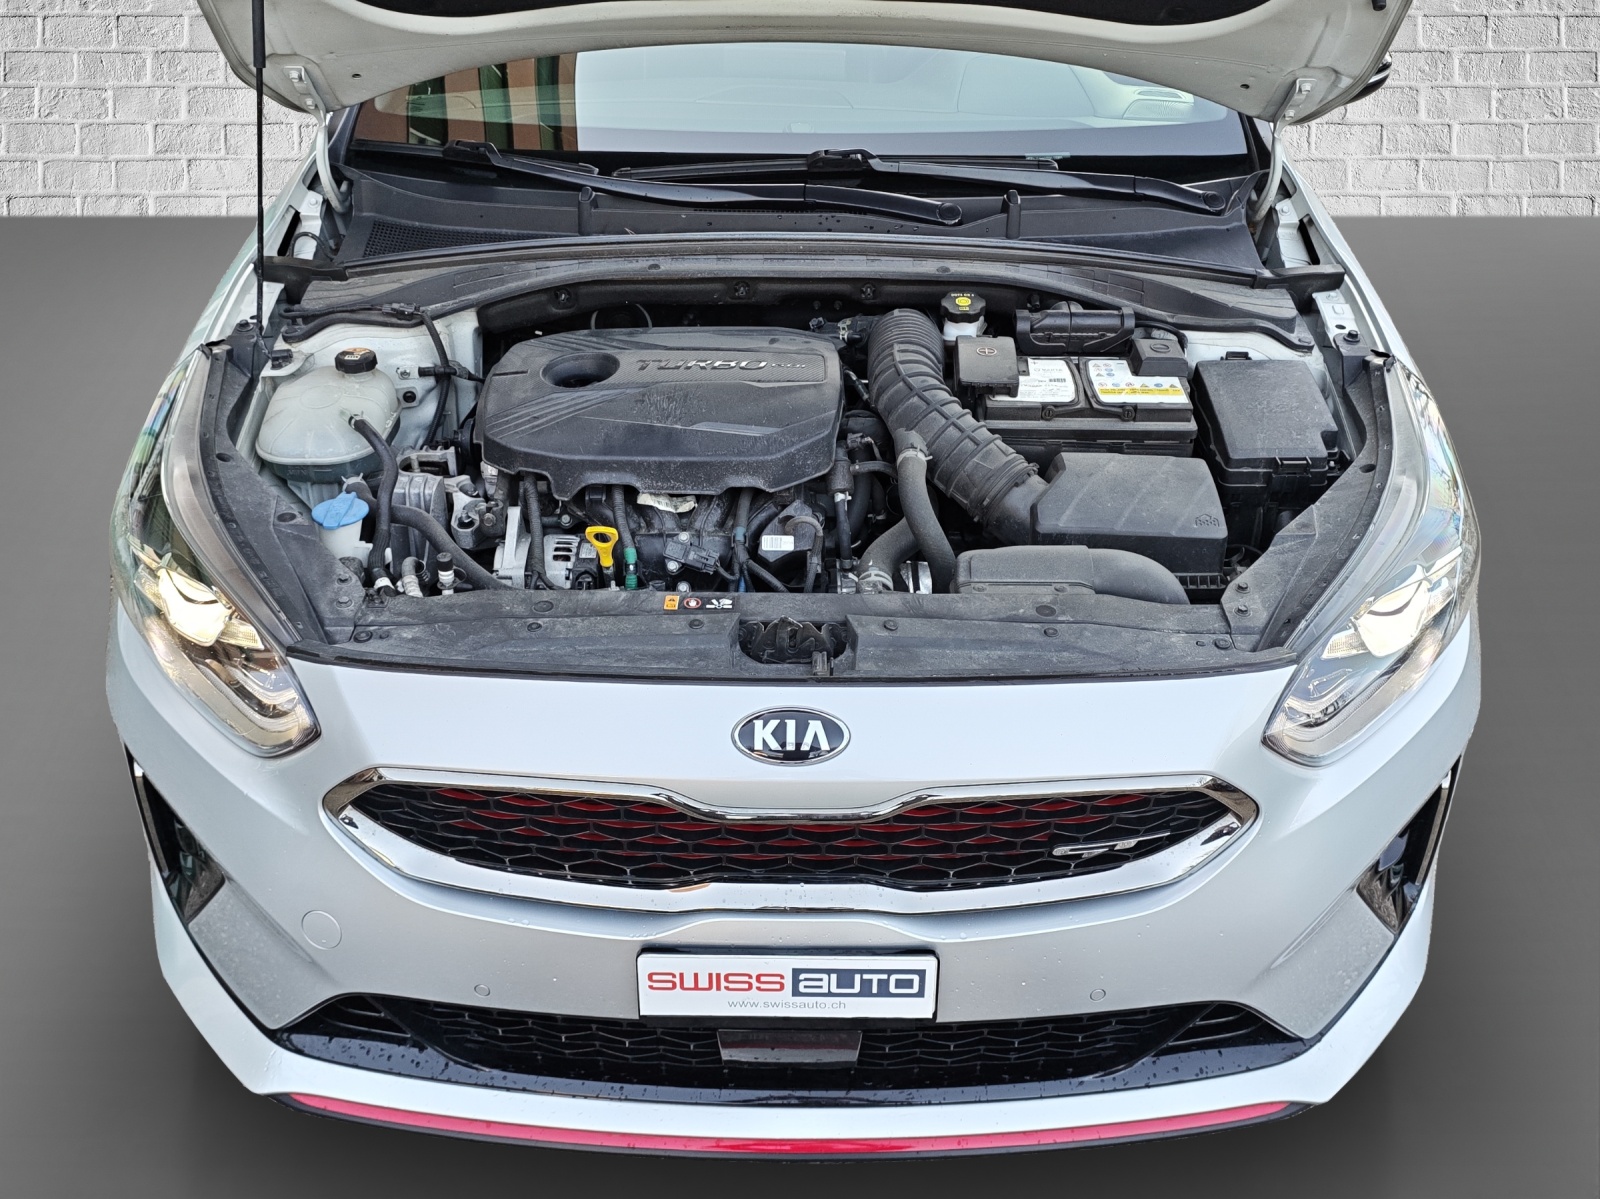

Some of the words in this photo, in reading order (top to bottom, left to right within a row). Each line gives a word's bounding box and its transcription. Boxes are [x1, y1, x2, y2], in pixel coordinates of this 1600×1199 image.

[637, 359, 768, 371] TURBO
[753, 719, 831, 751] KIA
[647, 971, 785, 992] SWISS
[727, 999, 847, 1010] www.swissauto.ch
